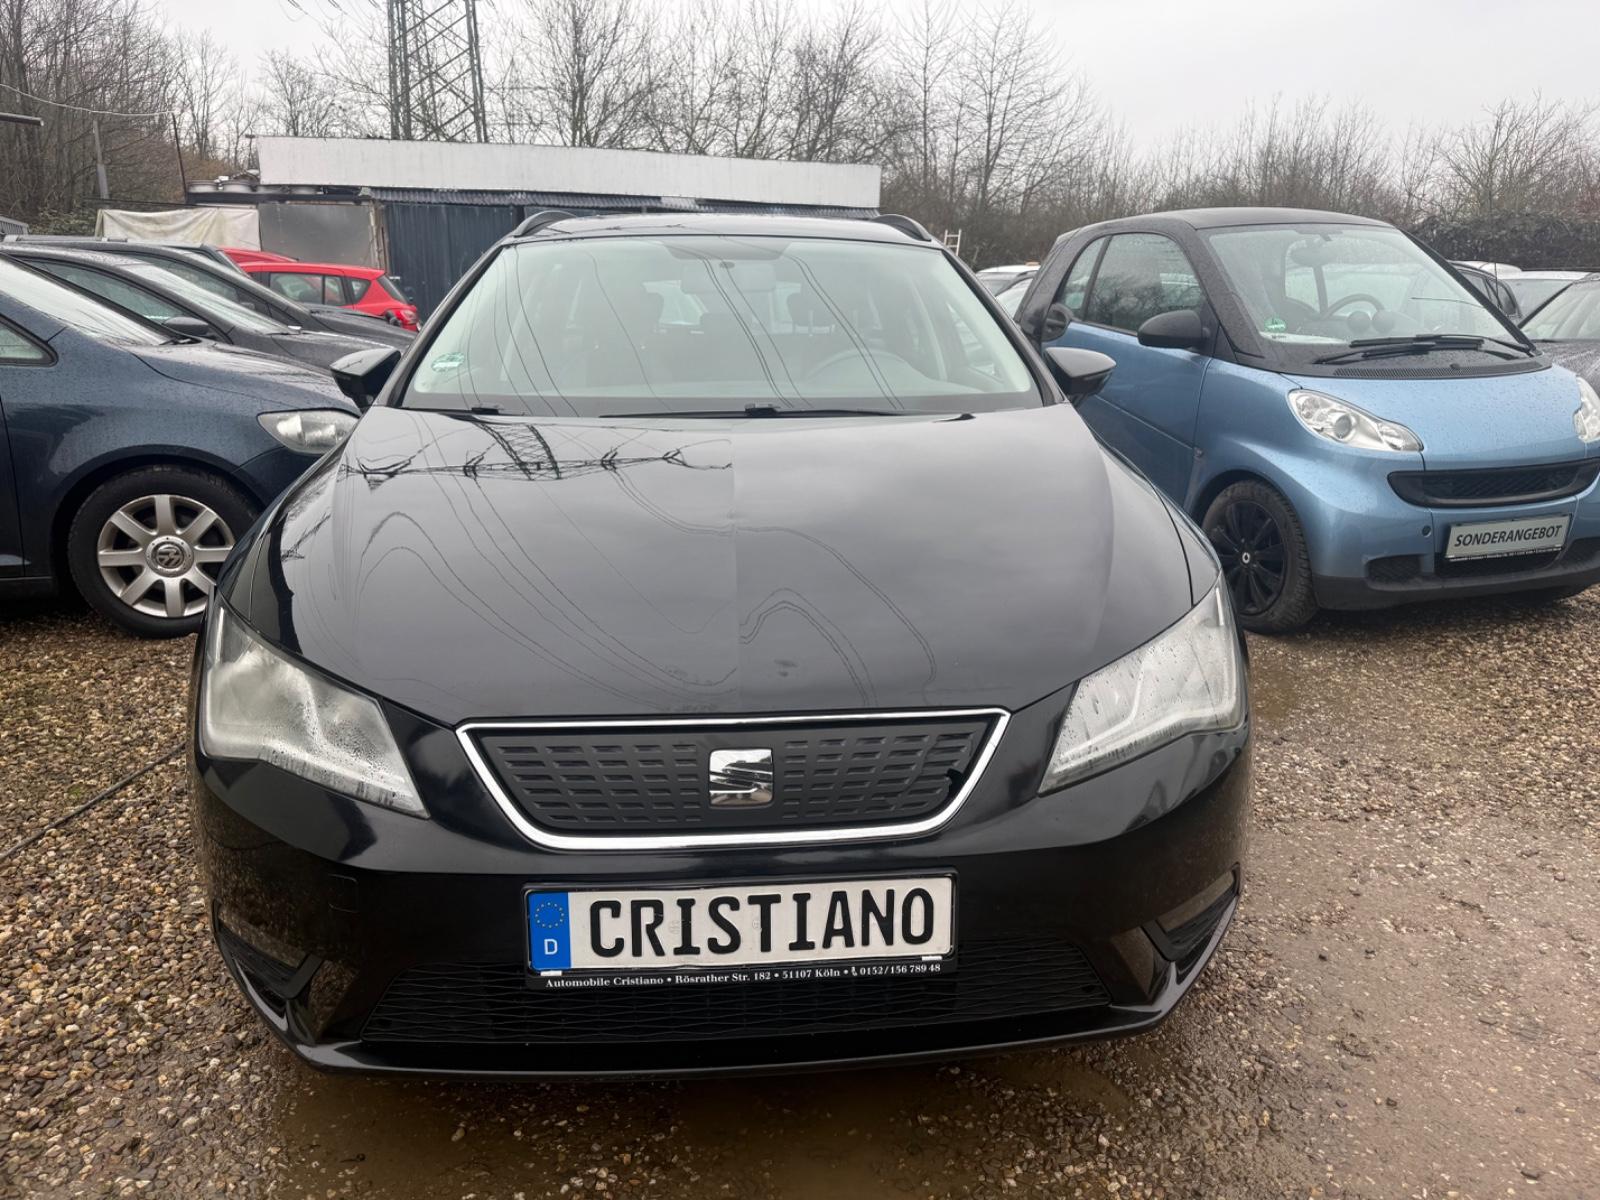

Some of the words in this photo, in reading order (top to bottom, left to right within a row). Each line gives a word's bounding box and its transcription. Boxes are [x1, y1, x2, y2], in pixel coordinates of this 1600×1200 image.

[1454, 525, 1562, 547] SONDERANGEBOT
[589, 887, 934, 958] CRISTIANO
[544, 938, 558, 955] D
[545, 977, 611, 988] Automobile
[613, 976, 664, 986] Cristiano
[675, 974, 729, 984] Rösrather
[731, 973, 750, 981] Str.
[754, 971, 771, 980] 182
[782, 970, 812, 979] 51107
[815, 969, 840, 977] Köln
[909, 965, 927, 974] 789
[928, 964, 941, 972] 48
